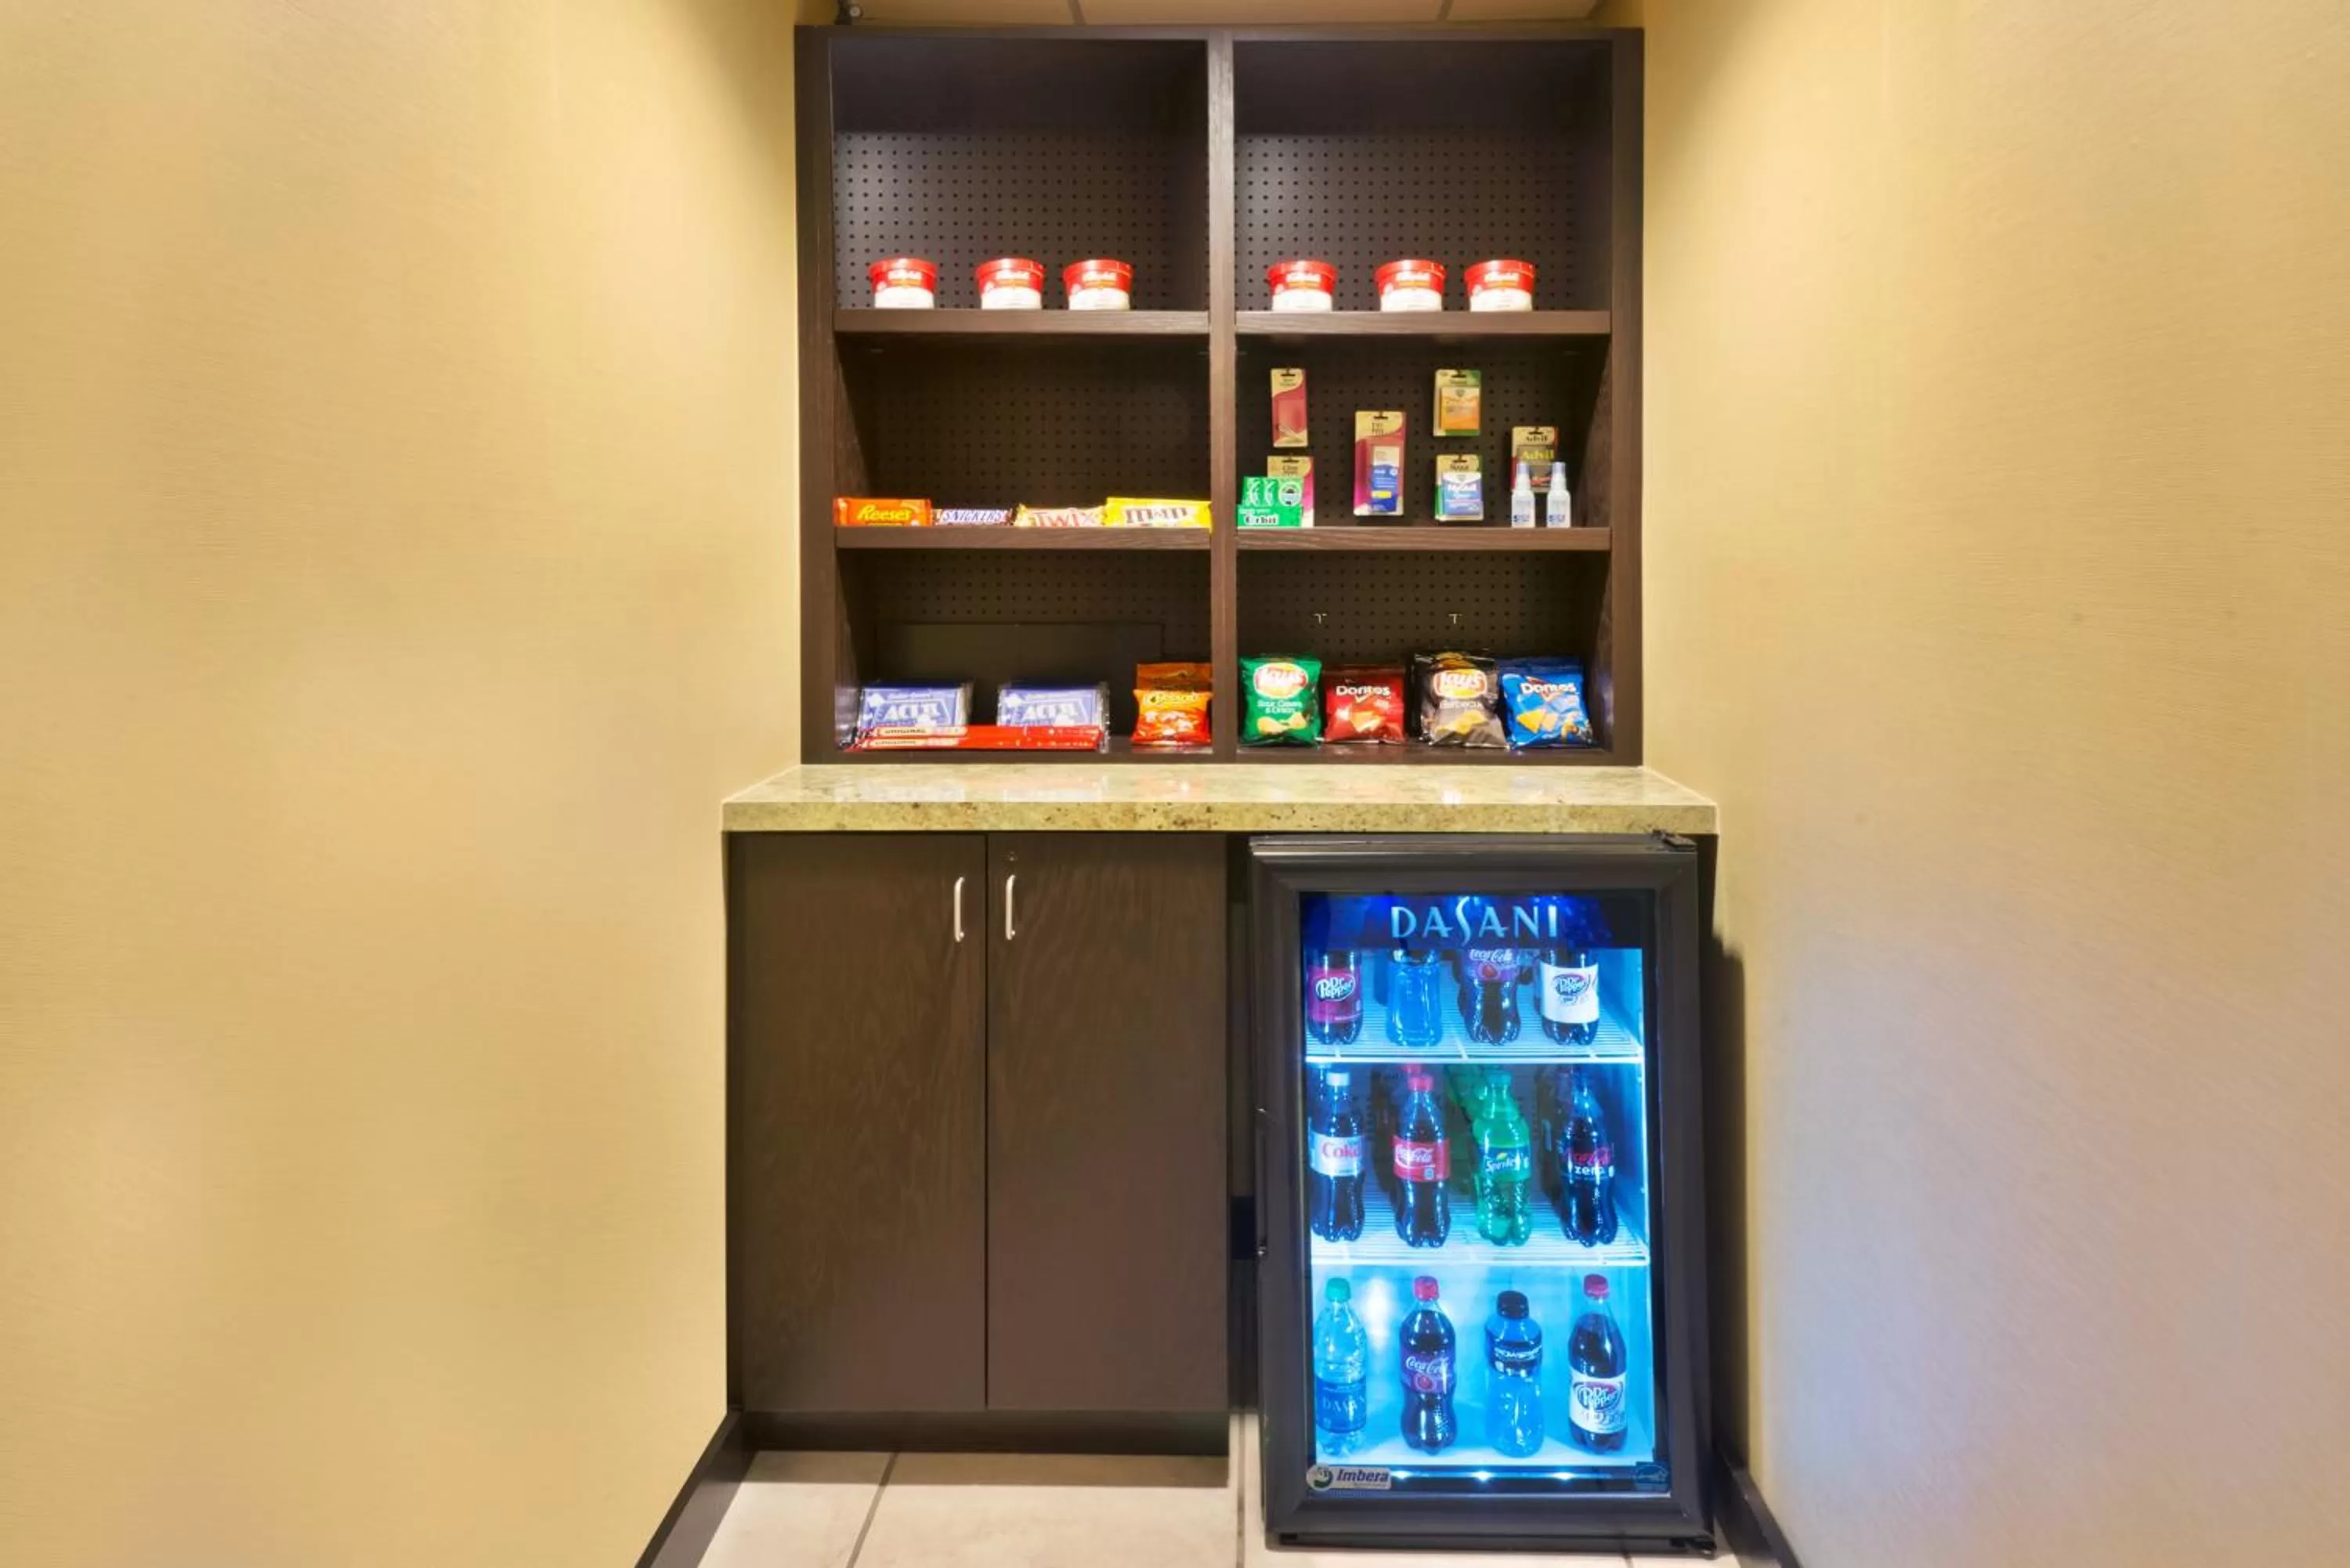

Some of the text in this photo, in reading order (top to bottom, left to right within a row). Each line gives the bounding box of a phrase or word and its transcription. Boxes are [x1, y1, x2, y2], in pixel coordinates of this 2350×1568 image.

[1336, 685, 1391, 696] Doritos
[1520, 682, 1577, 695] Doritos
[1391, 896, 1557, 946] DASANI
[1336, 1469, 1389, 1482] Imbera
